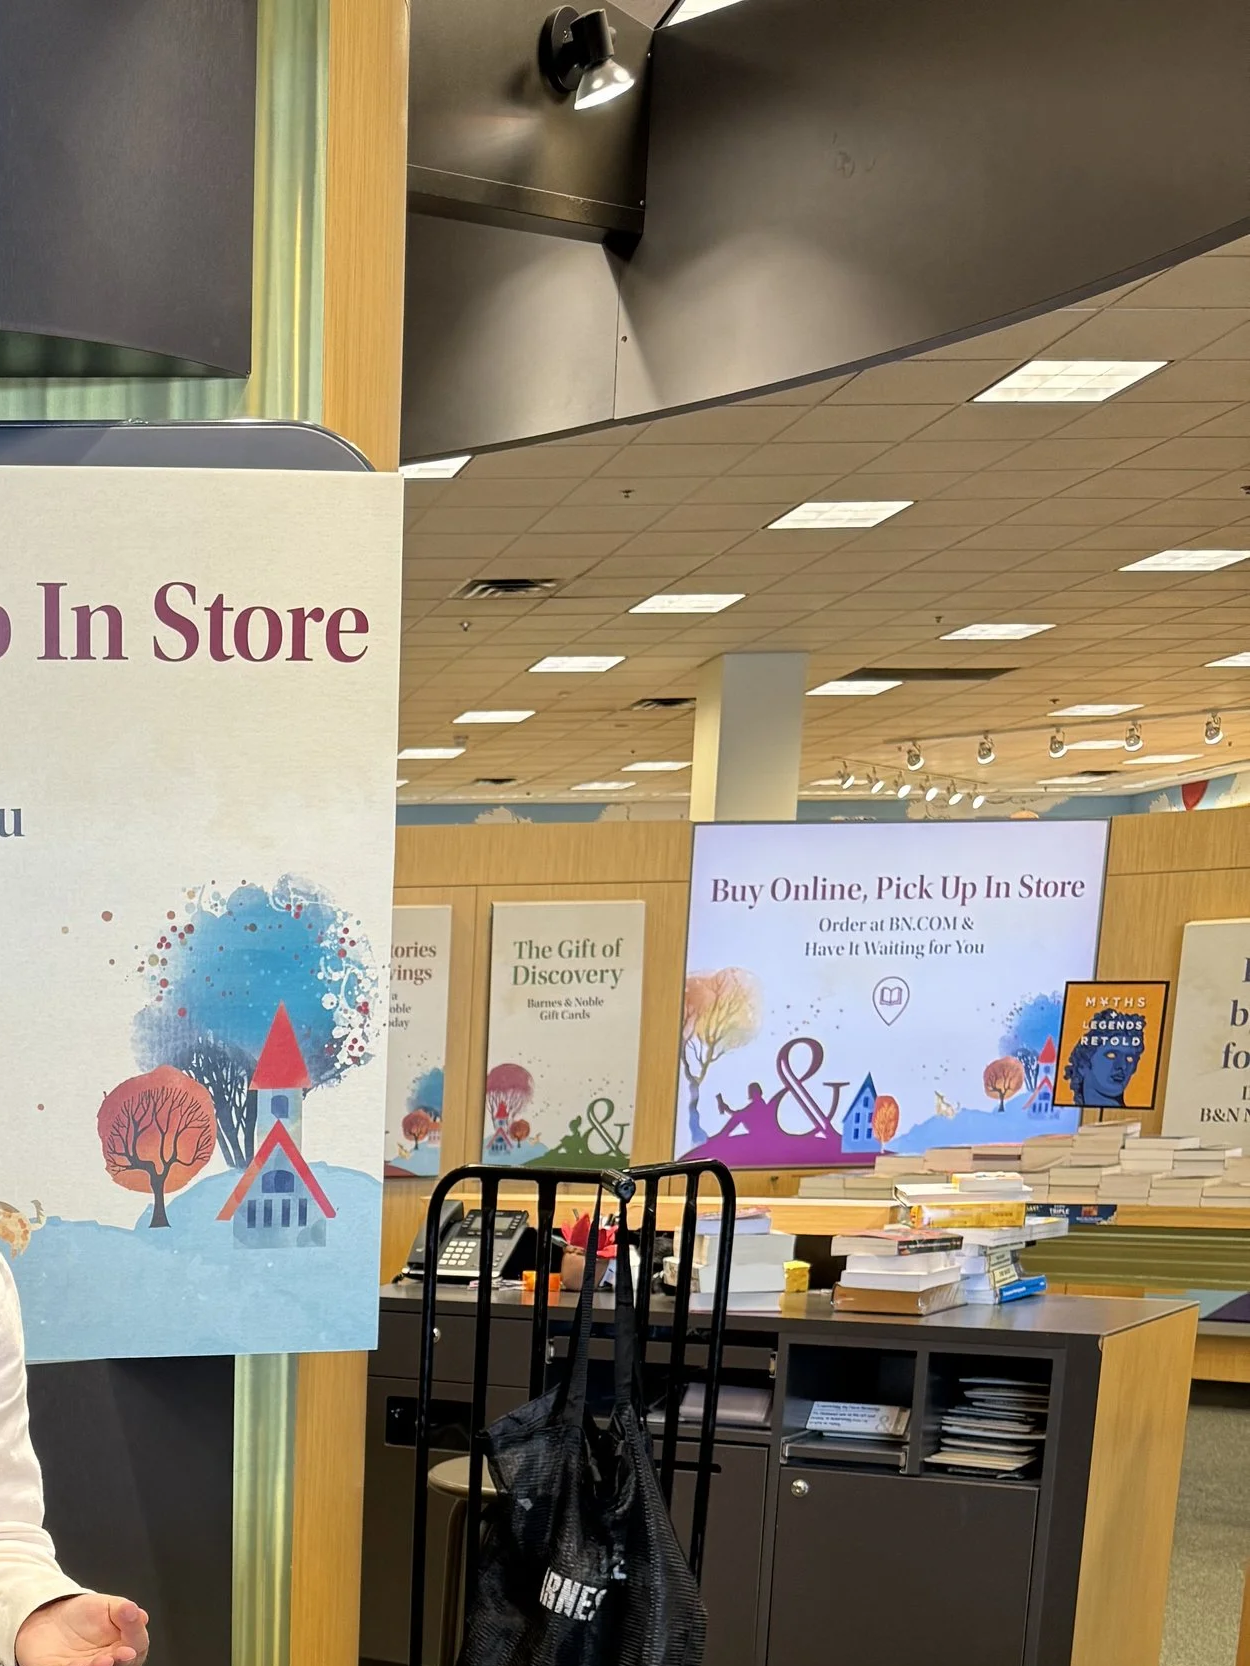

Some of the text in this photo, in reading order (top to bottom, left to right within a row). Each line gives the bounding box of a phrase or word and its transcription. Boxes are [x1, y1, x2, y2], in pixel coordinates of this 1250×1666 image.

[35, 581, 129, 661] In
[151, 580, 369, 664] Store
[711, 873, 1086, 910] Buy Online, Pick Up In Store
[819, 916, 974, 933] Order at BN.COM &
[513, 937, 624, 960] The Gift of
[805, 938, 985, 960] Have It Waiting for You
[511, 964, 625, 990] Discovery
[526, 996, 604, 1009] Barnes & Noble
[1085, 996, 1147, 1008] MYTHS
[539, 1009, 591, 1021] Gift Cards
[1082, 1020, 1143, 1030] LEGENDS
[1080, 1036, 1141, 1046] RETOLD
[1200, 1107, 1240, 1123] B&N
